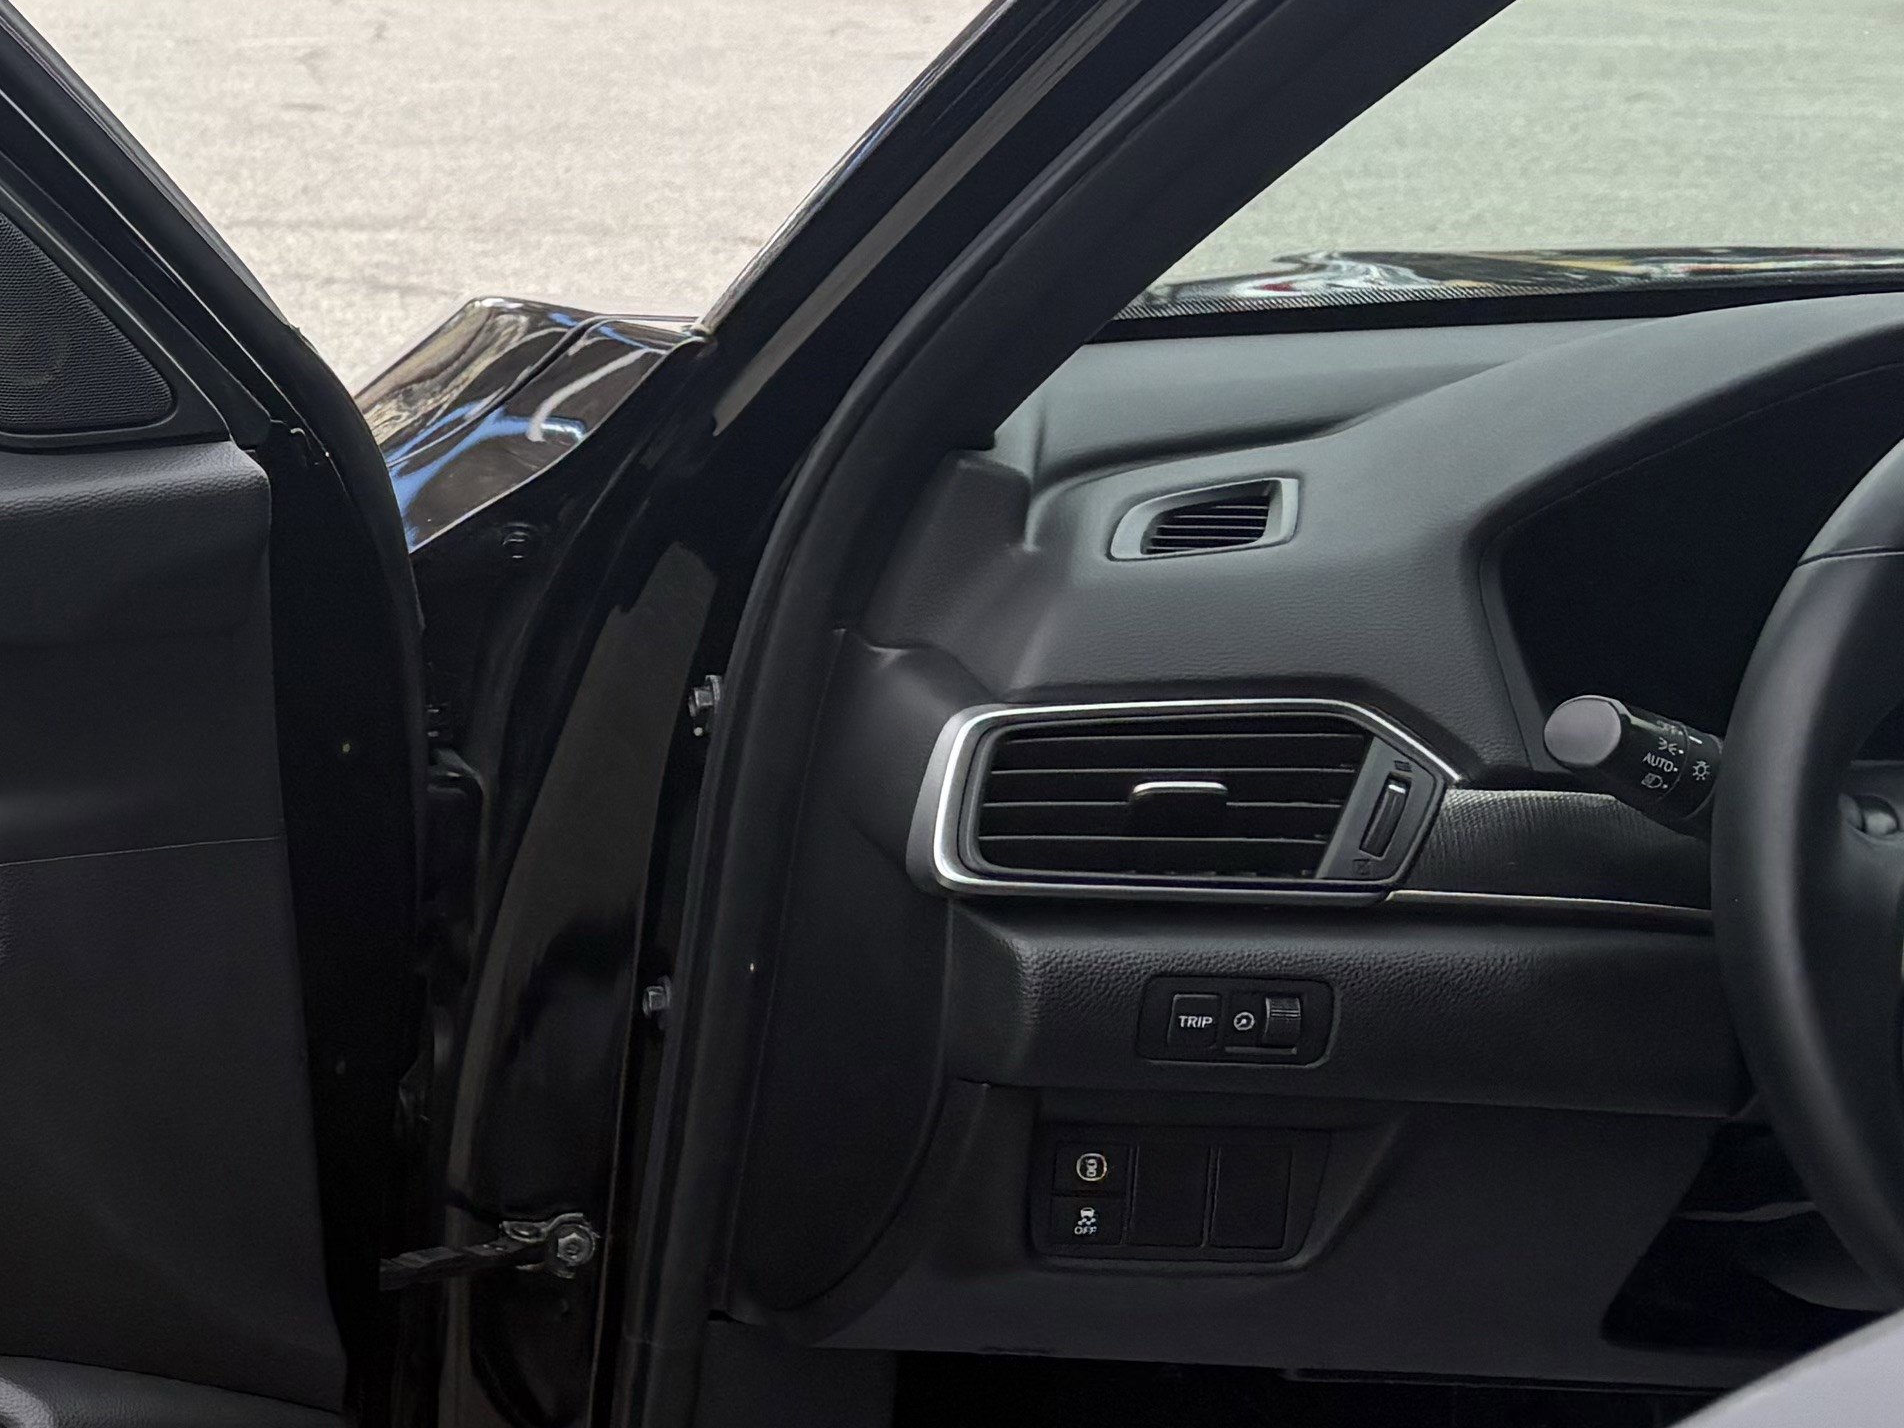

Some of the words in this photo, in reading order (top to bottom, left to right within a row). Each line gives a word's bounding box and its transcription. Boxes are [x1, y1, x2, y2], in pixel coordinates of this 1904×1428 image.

[1641, 752, 1674, 773] AUTO
[1178, 1015, 1213, 1029] TRIP
[1074, 1225, 1098, 1236] OFF
